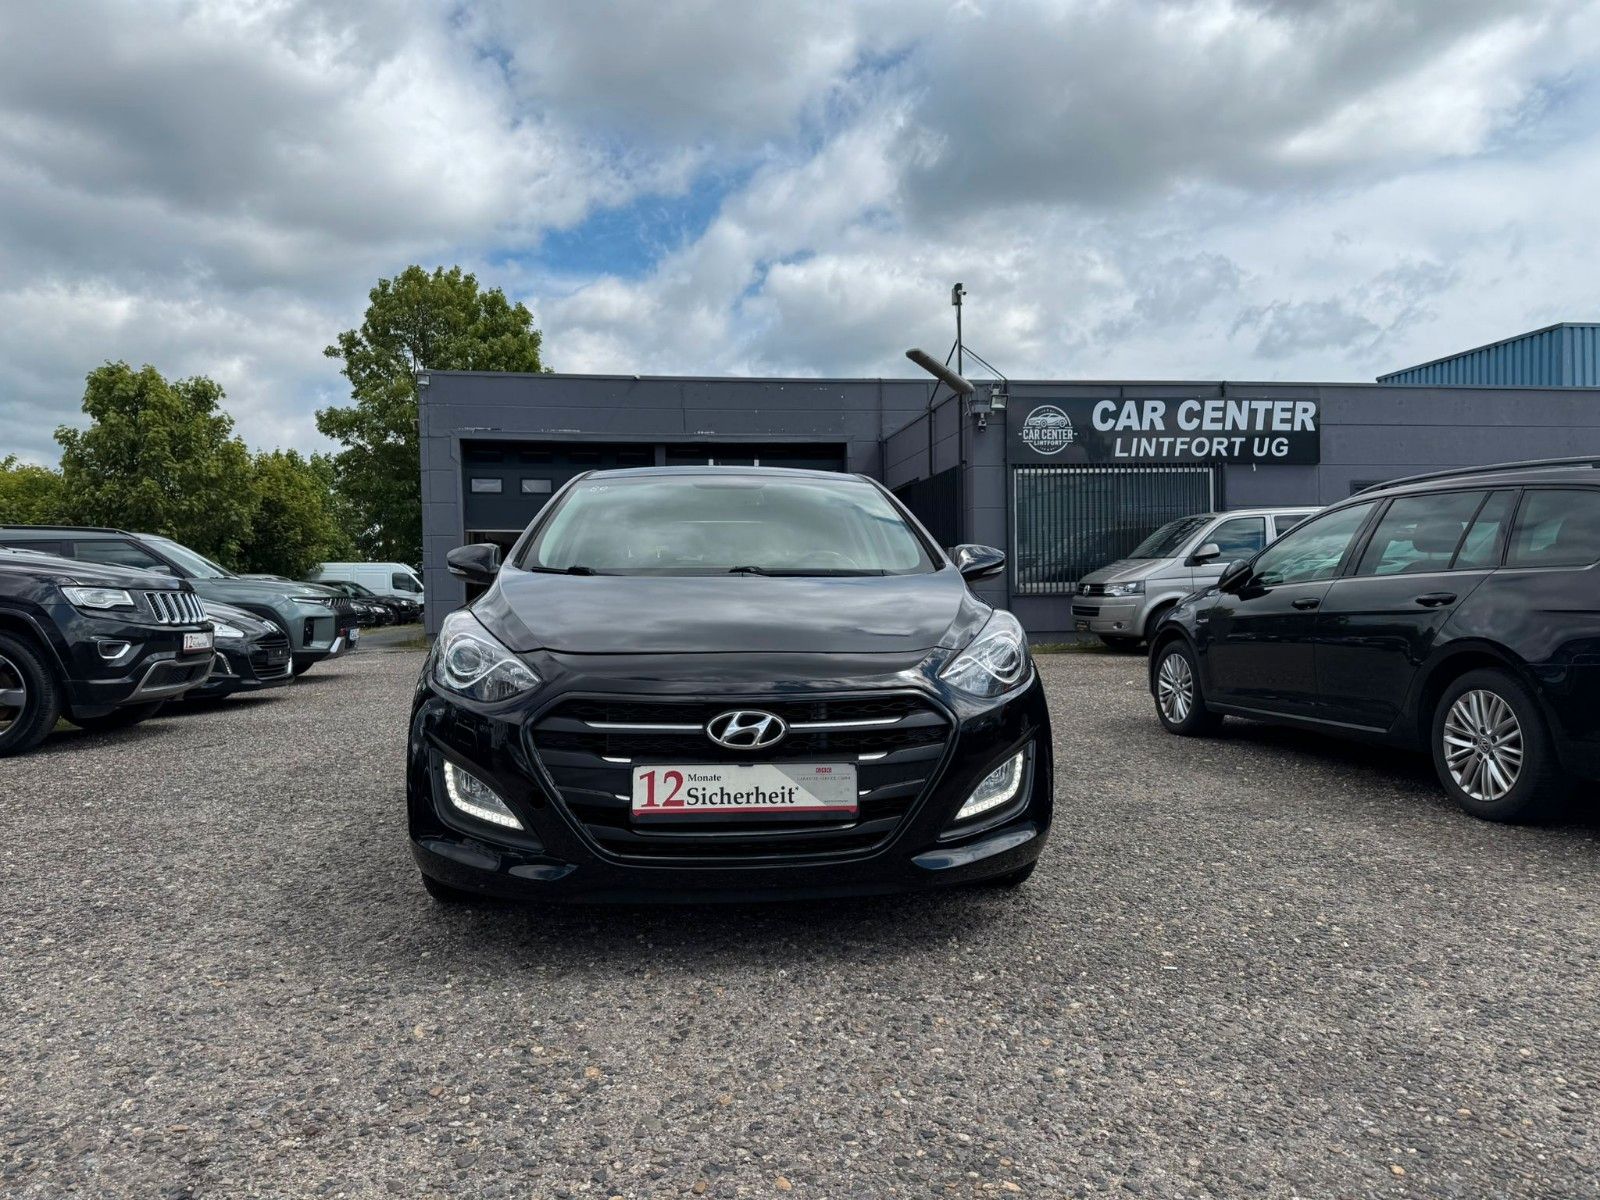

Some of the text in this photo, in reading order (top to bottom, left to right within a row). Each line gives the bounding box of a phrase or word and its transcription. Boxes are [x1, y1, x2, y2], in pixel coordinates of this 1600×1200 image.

[1092, 400, 1316, 431] CAR CENTER
[1023, 429, 1073, 440] CAR CENTER
[1115, 437, 1289, 457] LINTFORT UG
[687, 774, 722, 782] Monate
[639, 770, 685, 807] 12
